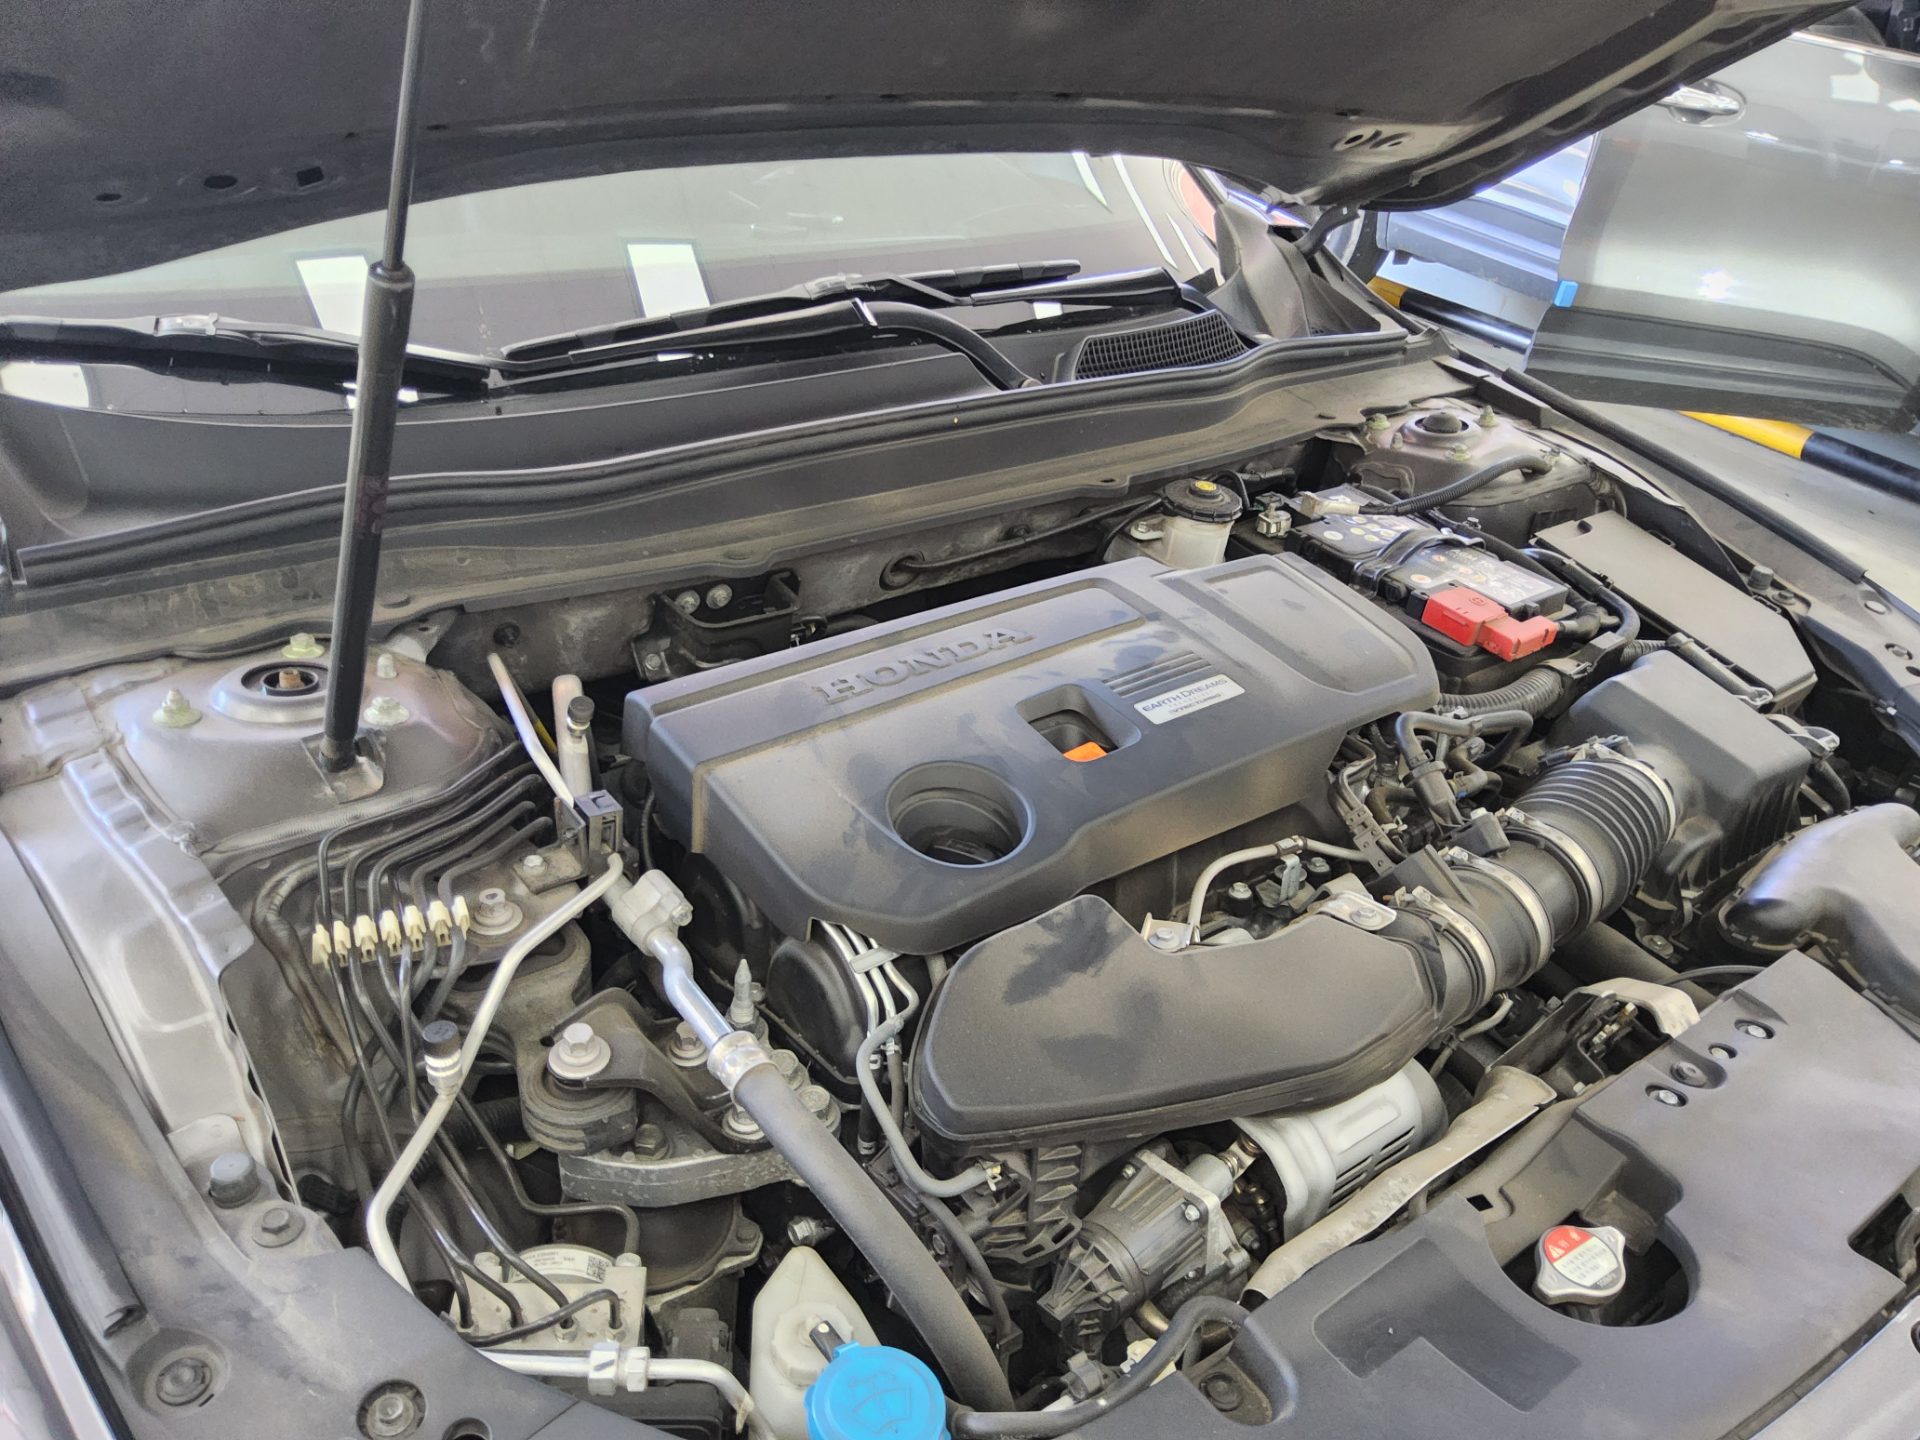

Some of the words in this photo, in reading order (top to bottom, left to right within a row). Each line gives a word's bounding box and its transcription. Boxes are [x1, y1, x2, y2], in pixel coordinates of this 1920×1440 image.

[812, 627, 1036, 705] HONDA
[1142, 694, 1181, 712] EARTH
[1180, 679, 1228, 698] DREAMS
